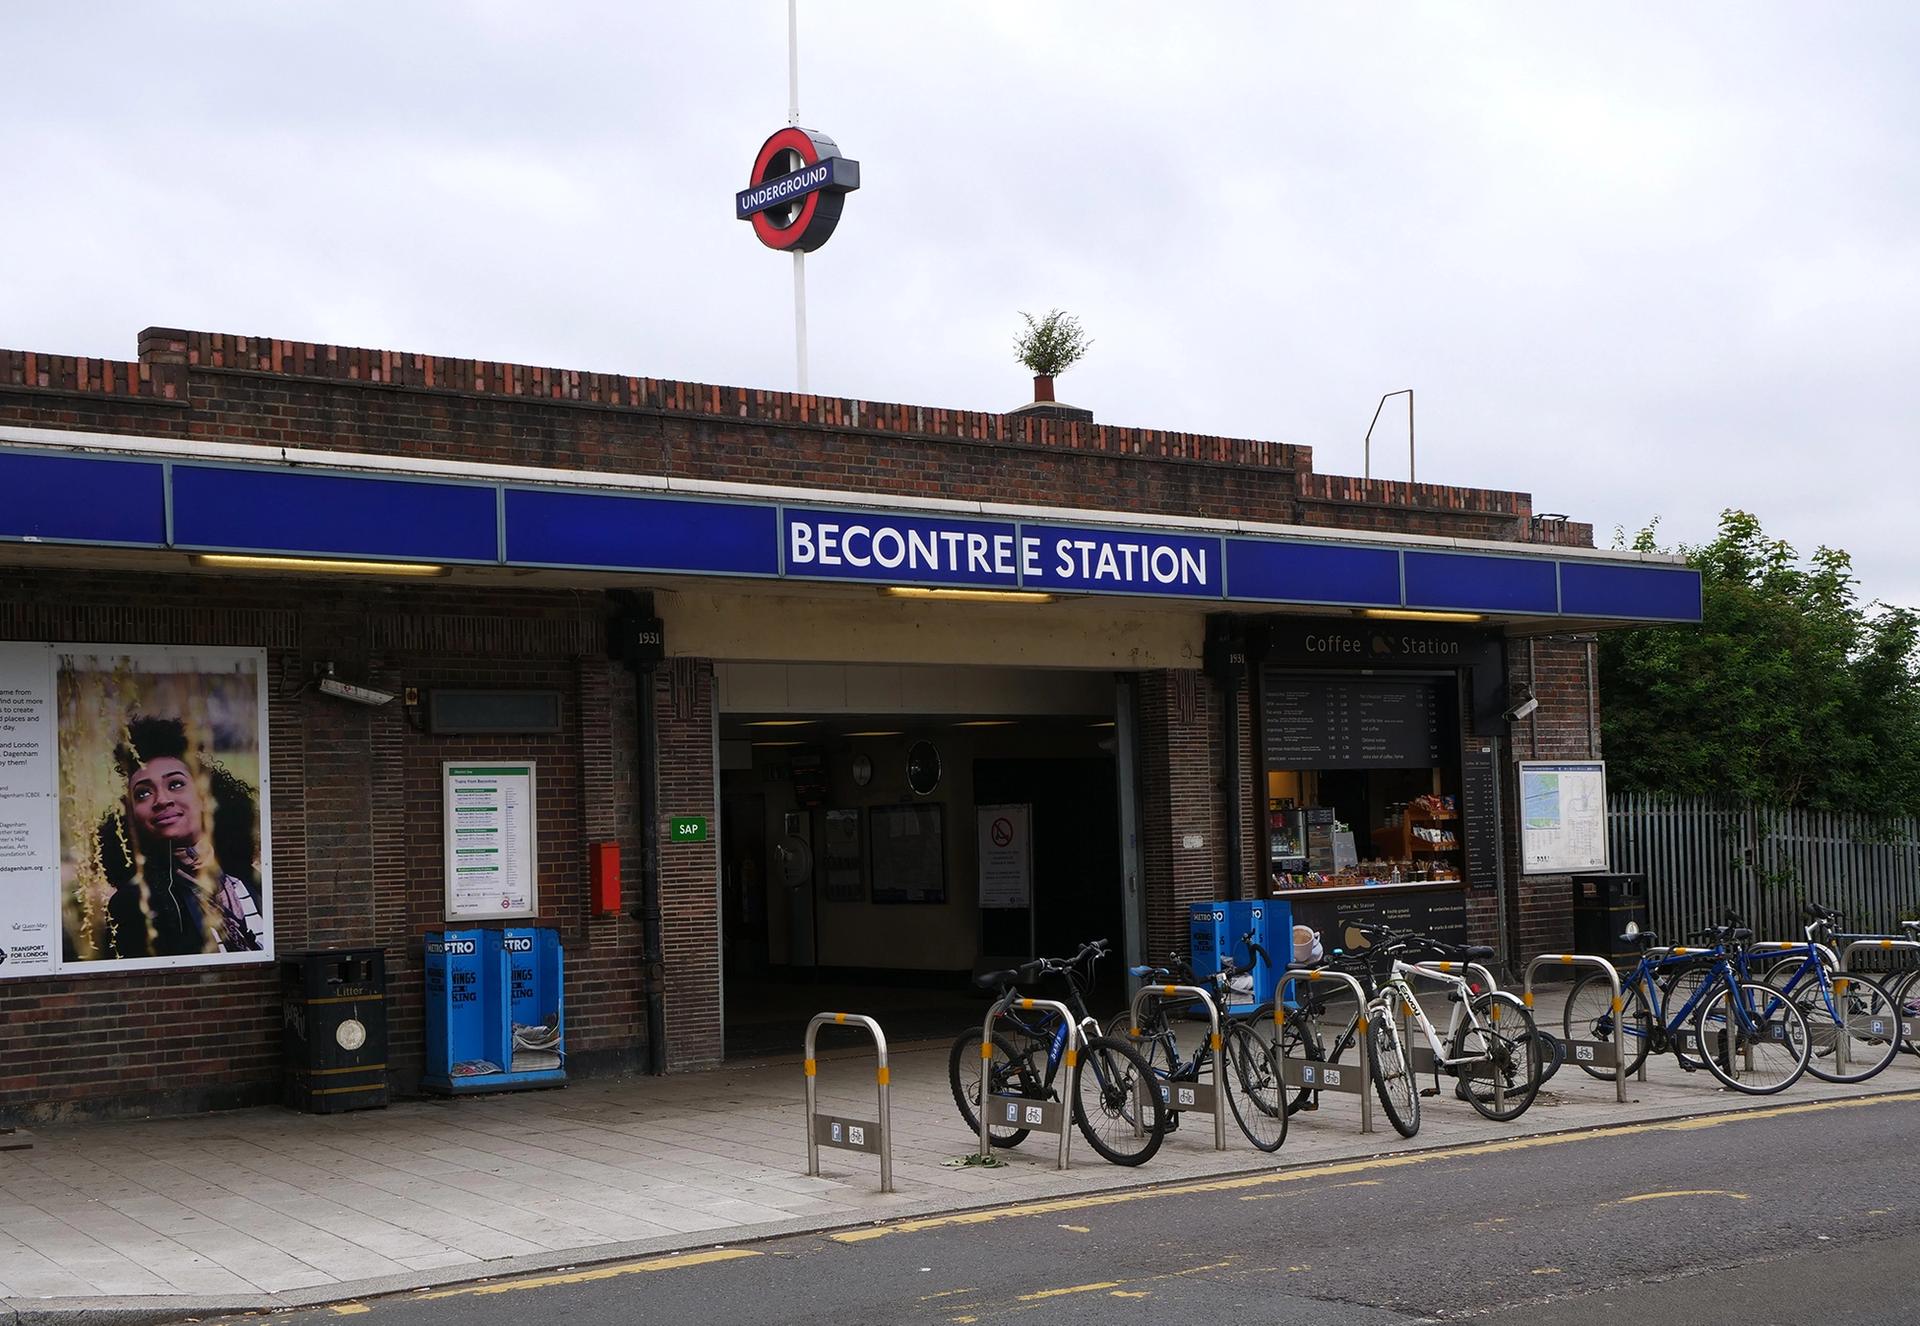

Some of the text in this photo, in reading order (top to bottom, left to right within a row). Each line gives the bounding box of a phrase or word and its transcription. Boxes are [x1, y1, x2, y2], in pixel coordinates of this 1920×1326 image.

[742, 166, 828, 210] UNDERGROUND
[791, 521, 1207, 585] BECONTREE STATION
[638, 632, 661, 645] 1931
[1305, 635, 1459, 654] Coffee Station
[1229, 653, 1245, 664] 1931
[3, 750, 39, 758] Dagenham
[679, 824, 699, 835] SAP
[1192, 912, 1212, 922] METRO
[425, 943, 444, 953] METRO
[335, 986, 363, 997] Litter
[1873, 1022, 1881, 1032] P
[1305, 1068, 1313, 1081] P
[1008, 1105, 1016, 1119] P
[833, 1125, 839, 1138] P
